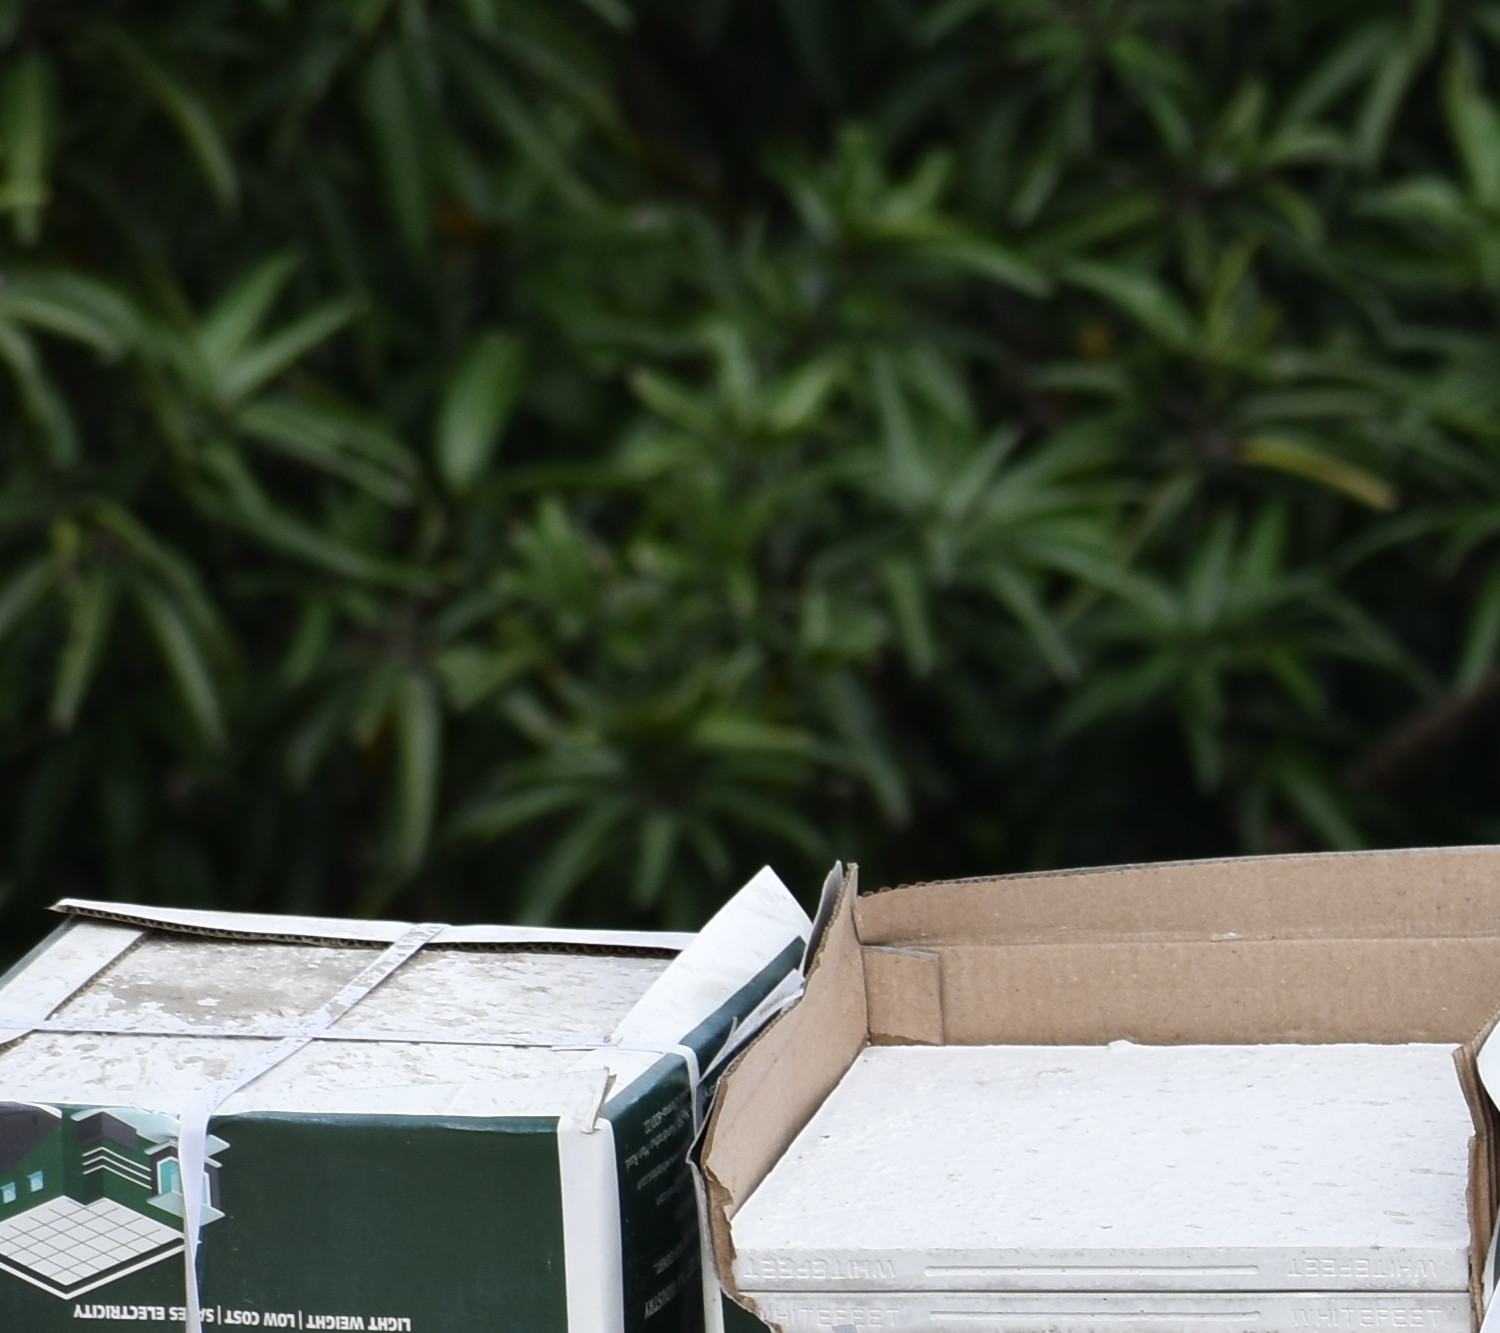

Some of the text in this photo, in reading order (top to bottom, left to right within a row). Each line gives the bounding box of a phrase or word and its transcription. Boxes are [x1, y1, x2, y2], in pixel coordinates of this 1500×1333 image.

[743, 1257, 895, 1279] WHITEFEET
[1286, 1257, 1438, 1278] WHITEFEET
[72, 1303, 412, 1333] LIGHT WEIGHT LOW COST ELECTRICITY
[1289, 1307, 1442, 1327] WHITEFEET
